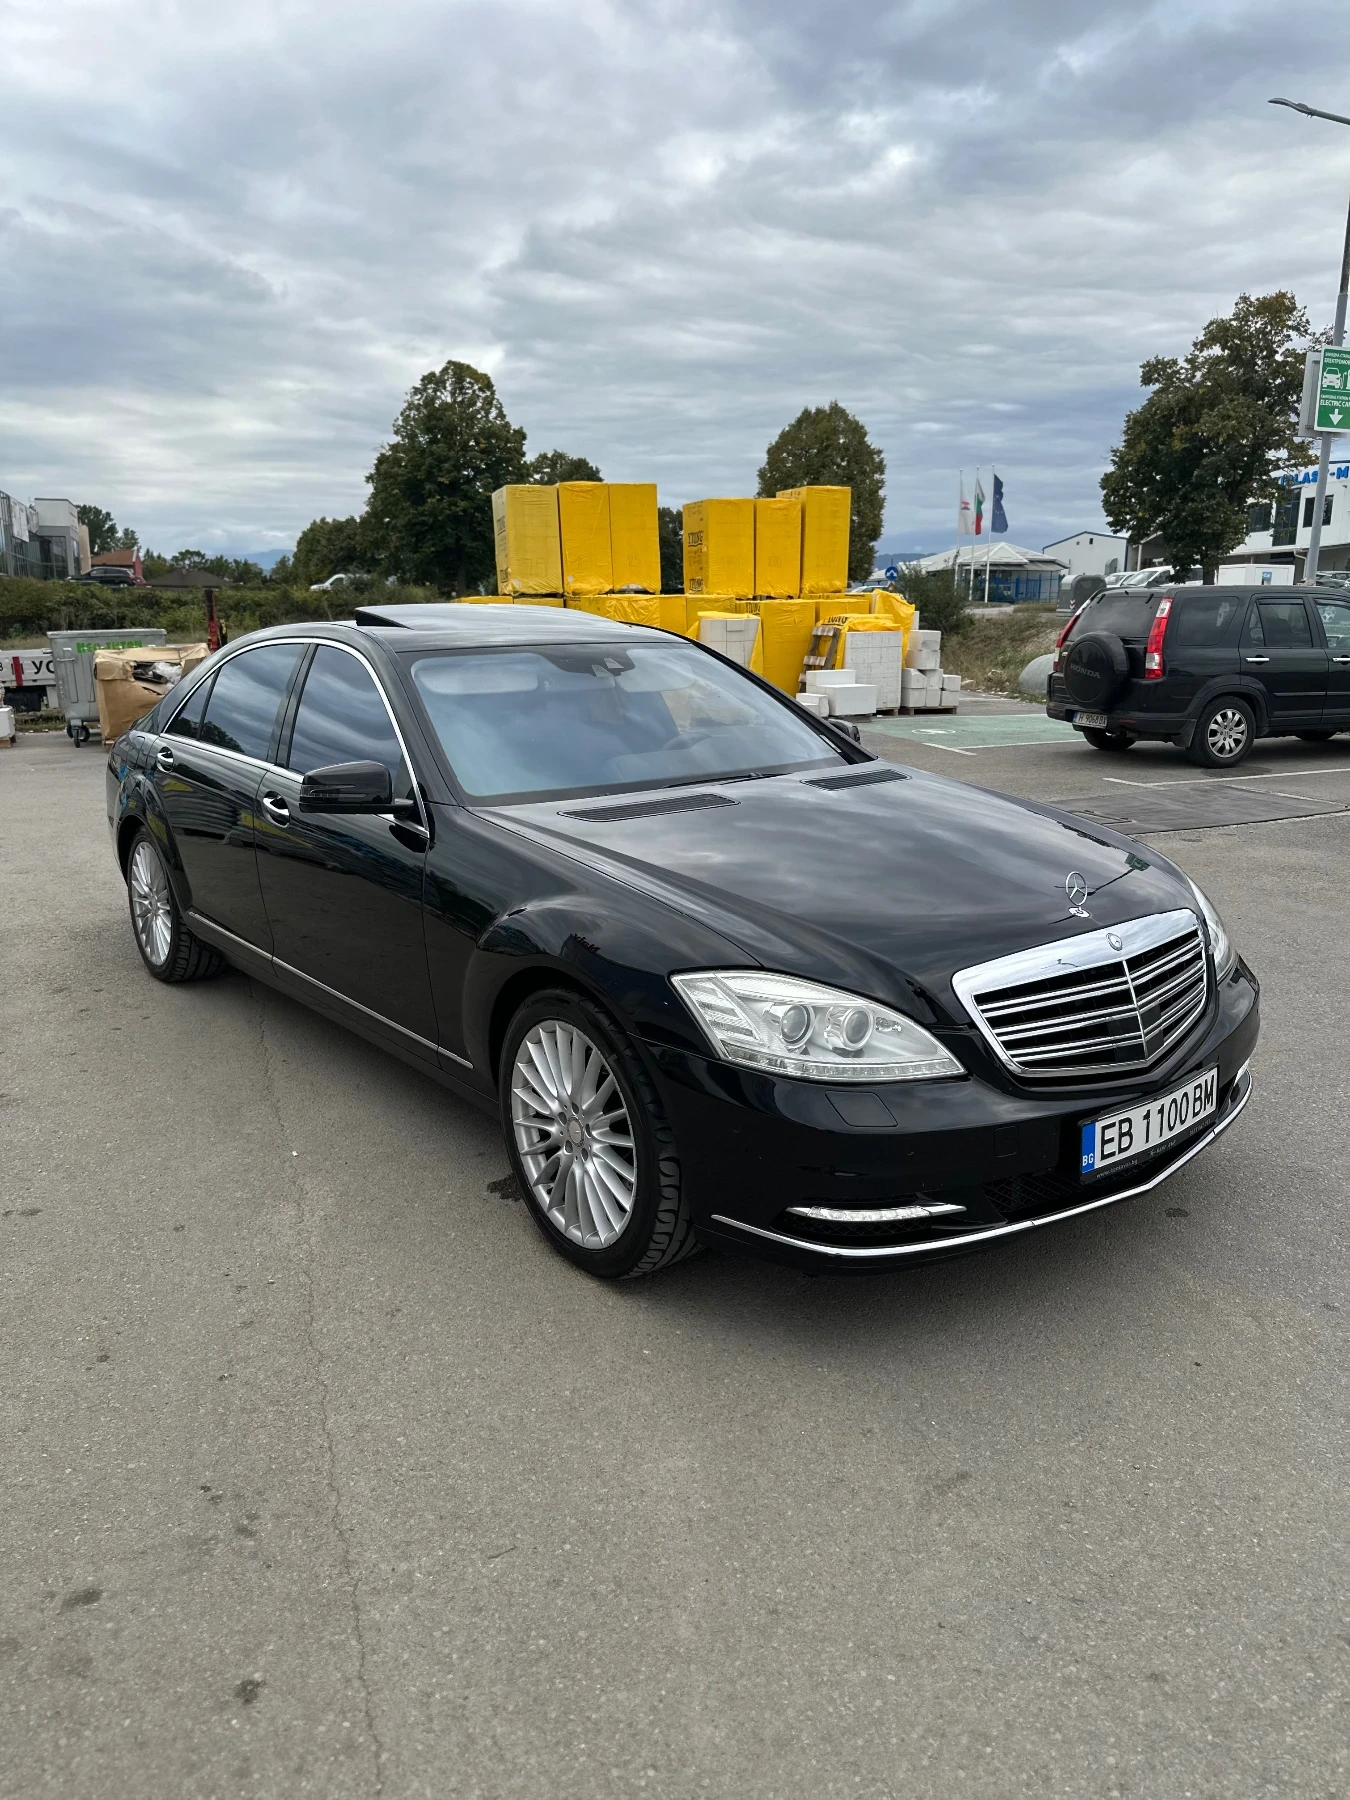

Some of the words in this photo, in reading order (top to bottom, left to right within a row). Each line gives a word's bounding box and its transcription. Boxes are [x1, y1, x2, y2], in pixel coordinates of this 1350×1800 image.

[1320, 399, 1341, 407] ELECTRIC
[1070, 663, 1101, 679] HONDA
[1100, 1117, 1134, 1161] EB
[1142, 1091, 1190, 1144] 1100
[1192, 1074, 1215, 1119] BM
[1082, 1153, 1094, 1166] BG
